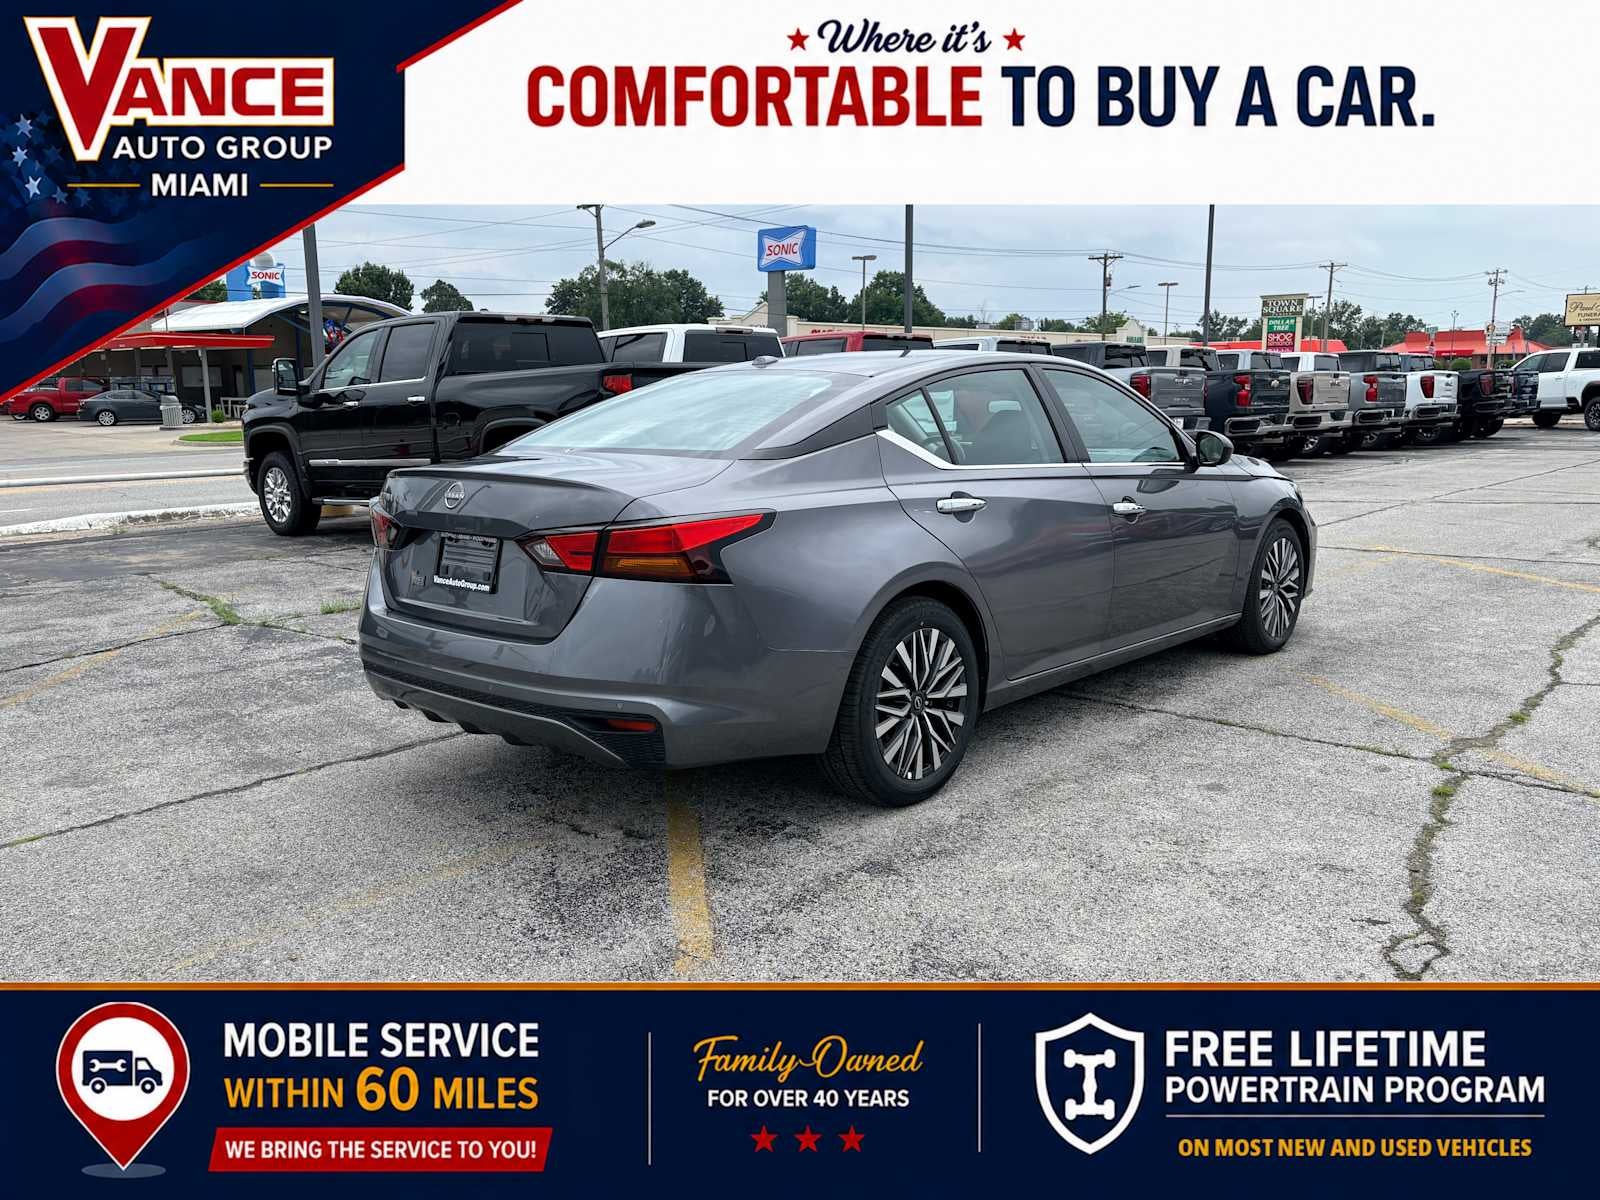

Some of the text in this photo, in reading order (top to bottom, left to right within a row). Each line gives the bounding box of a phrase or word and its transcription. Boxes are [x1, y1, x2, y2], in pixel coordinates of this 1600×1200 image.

[766, 242, 799, 257] SONIC
[251, 271, 280, 280] SONIC
[1267, 299, 1298, 307] TOWN
[1262, 305, 1304, 313] SQUARE
[433, 574, 491, 593] VanceAutoGroup.com
